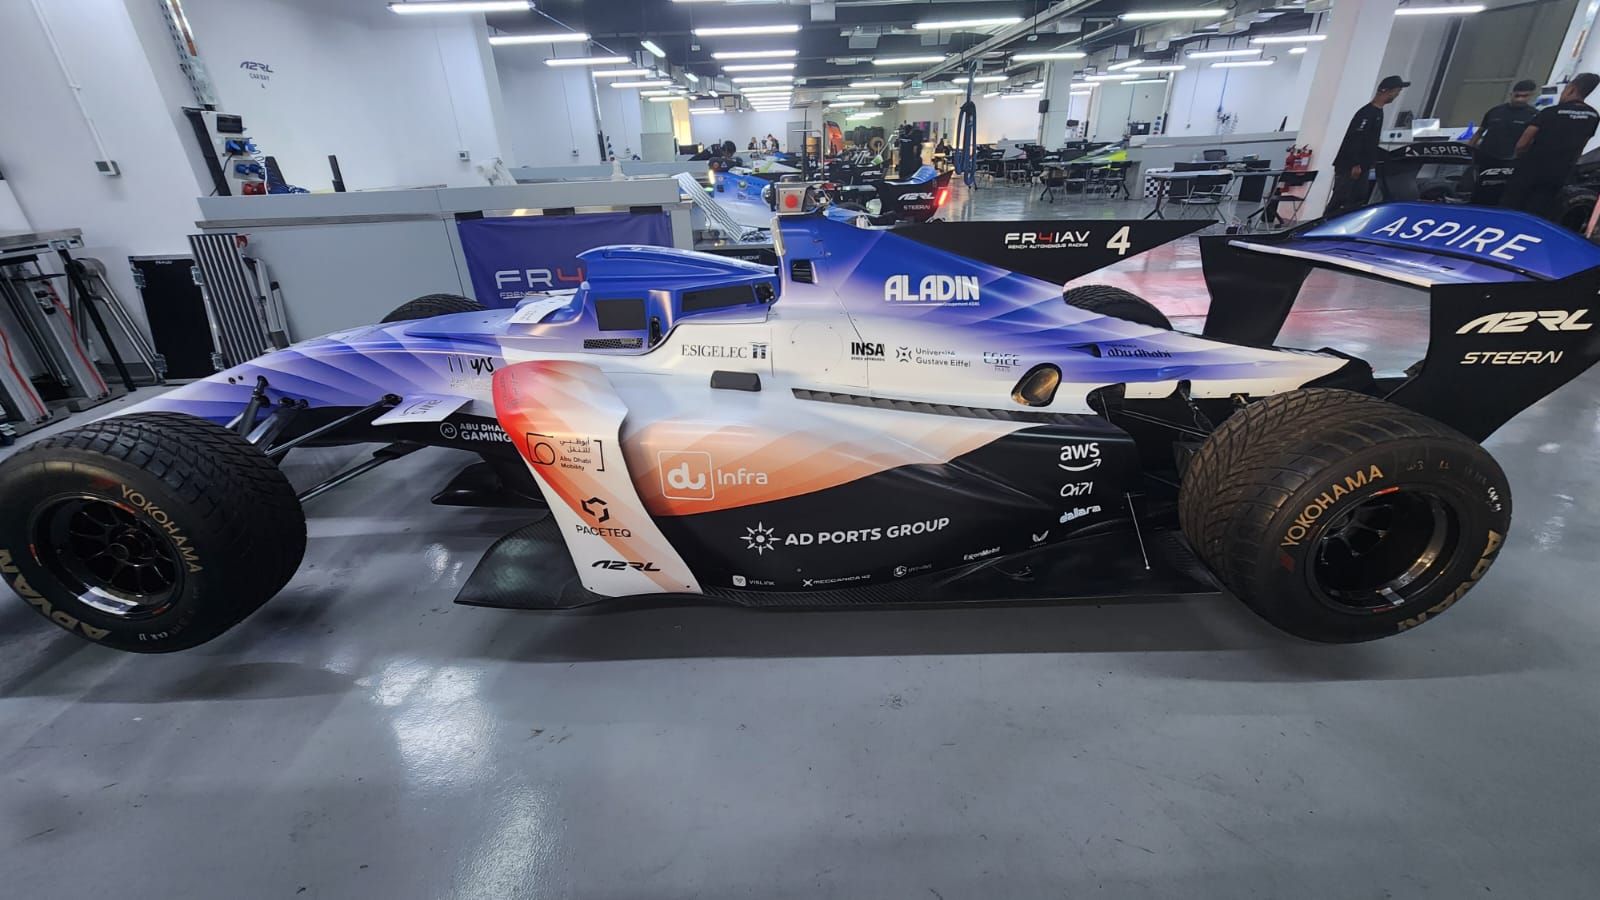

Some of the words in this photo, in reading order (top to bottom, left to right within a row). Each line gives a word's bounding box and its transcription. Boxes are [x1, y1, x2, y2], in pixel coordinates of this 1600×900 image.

[1423, 145, 1469, 155] ASPIRE
[1106, 225, 1131, 256] 4
[1371, 216, 1543, 260] ASPIRE
[884, 274, 980, 301] ALADIN
[1455, 309, 1593, 334] A2RL
[681, 344, 748, 359] ESIGELEC
[851, 342, 885, 357] INSA
[915, 357, 948, 366] Gustave
[950, 359, 971, 368] Eiffel
[461, 431, 512, 443] GAMING
[1060, 442, 1100, 461] aws
[667, 462, 706, 490] du
[717, 468, 768, 485] Infra
[1059, 505, 1102, 523] dallara
[1281, 464, 1384, 547] YOKOHAMA
[119, 484, 203, 573] YOKOHAMA
[575, 525, 632, 538] PACETEQ
[785, 533, 814, 546] AD
[818, 528, 882, 545] PORTS
[886, 517, 950, 539] GROUP
[591, 560, 661, 571] A2RL
